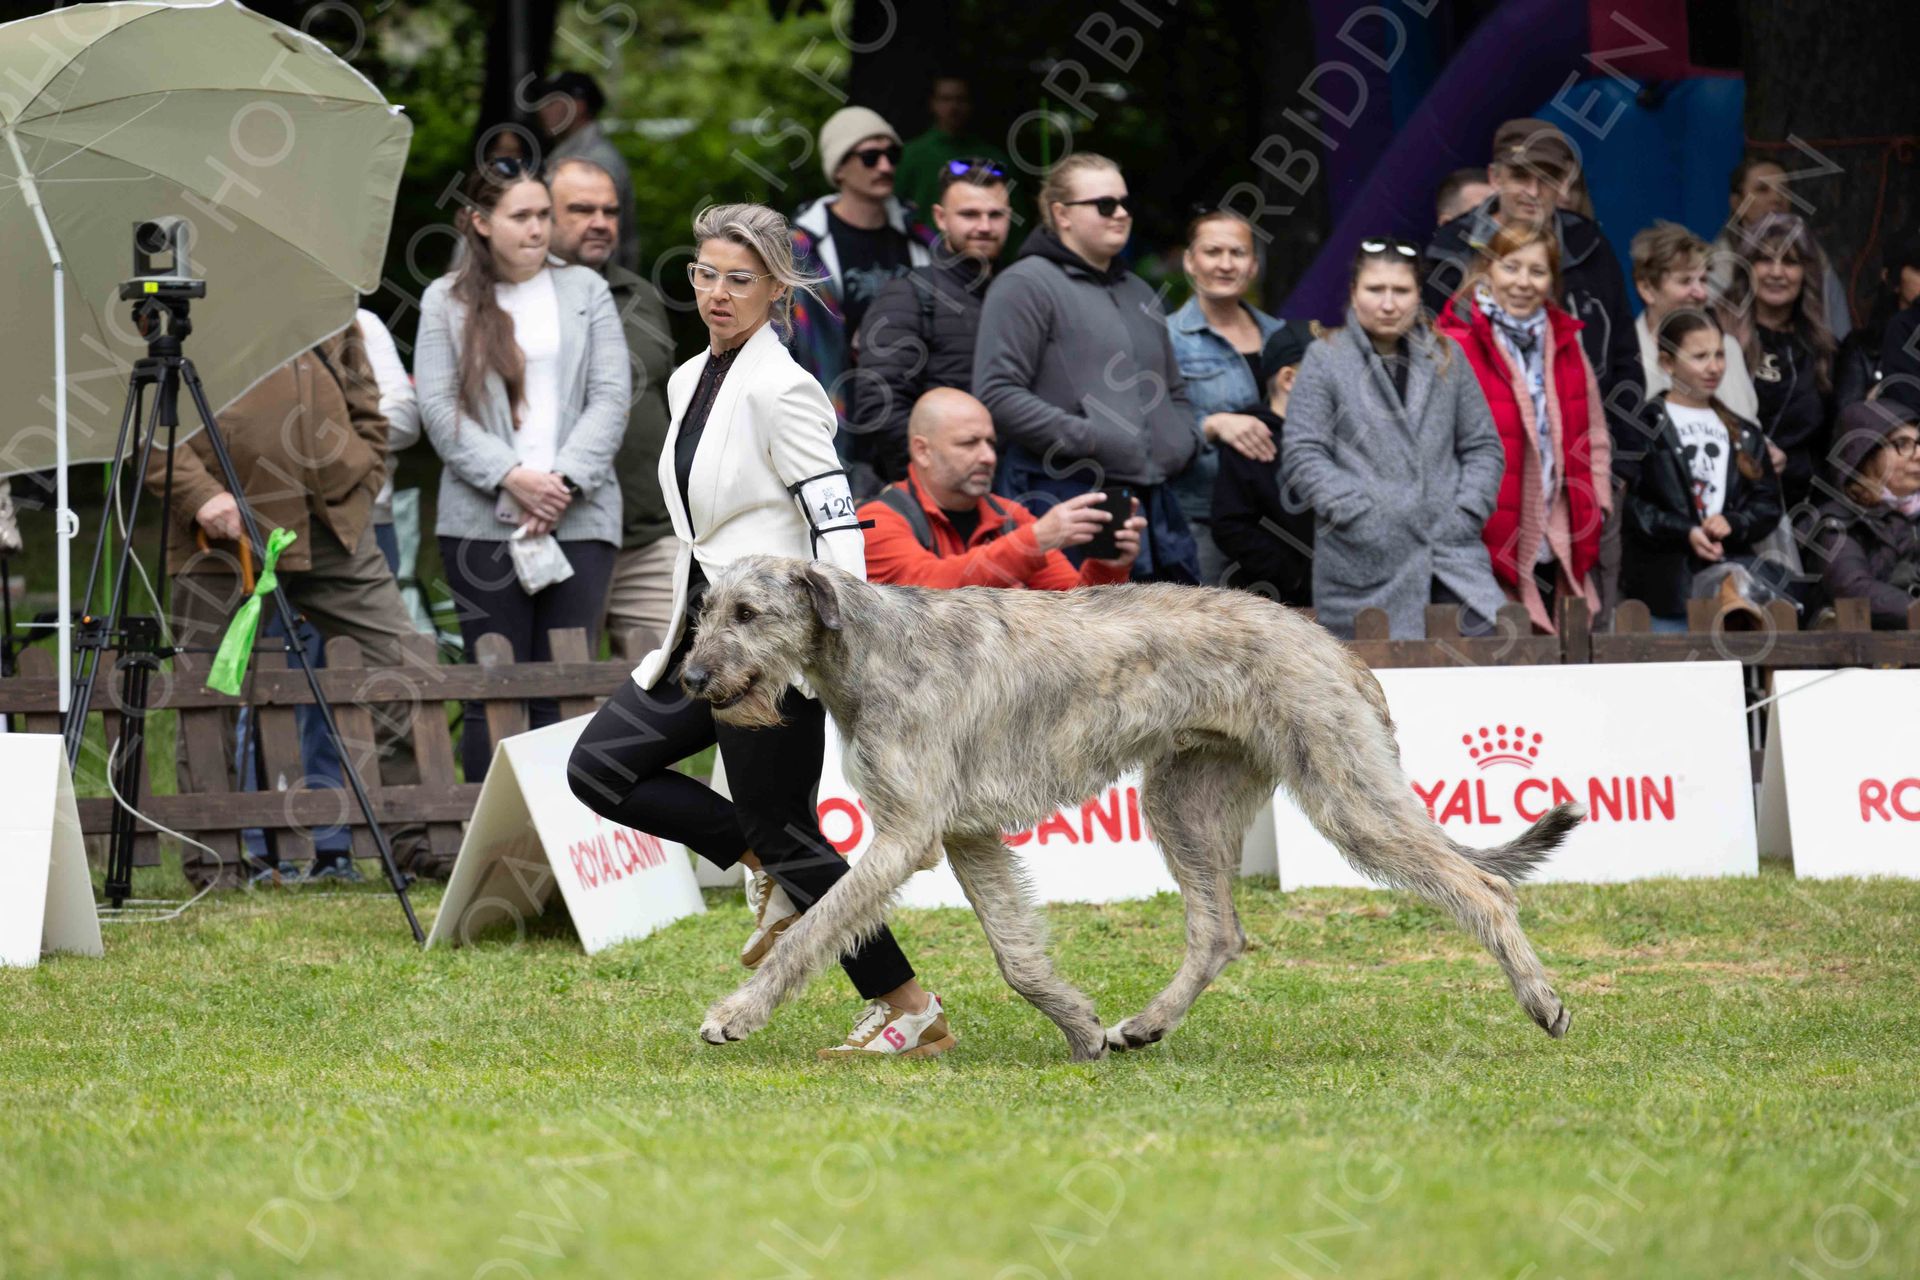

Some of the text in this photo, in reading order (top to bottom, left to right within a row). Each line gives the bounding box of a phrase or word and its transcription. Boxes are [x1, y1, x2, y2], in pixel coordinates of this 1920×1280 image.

[1410, 778, 1503, 825] YAL
[568, 834, 623, 891] ROYAL
[883, 1026, 906, 1050] G
